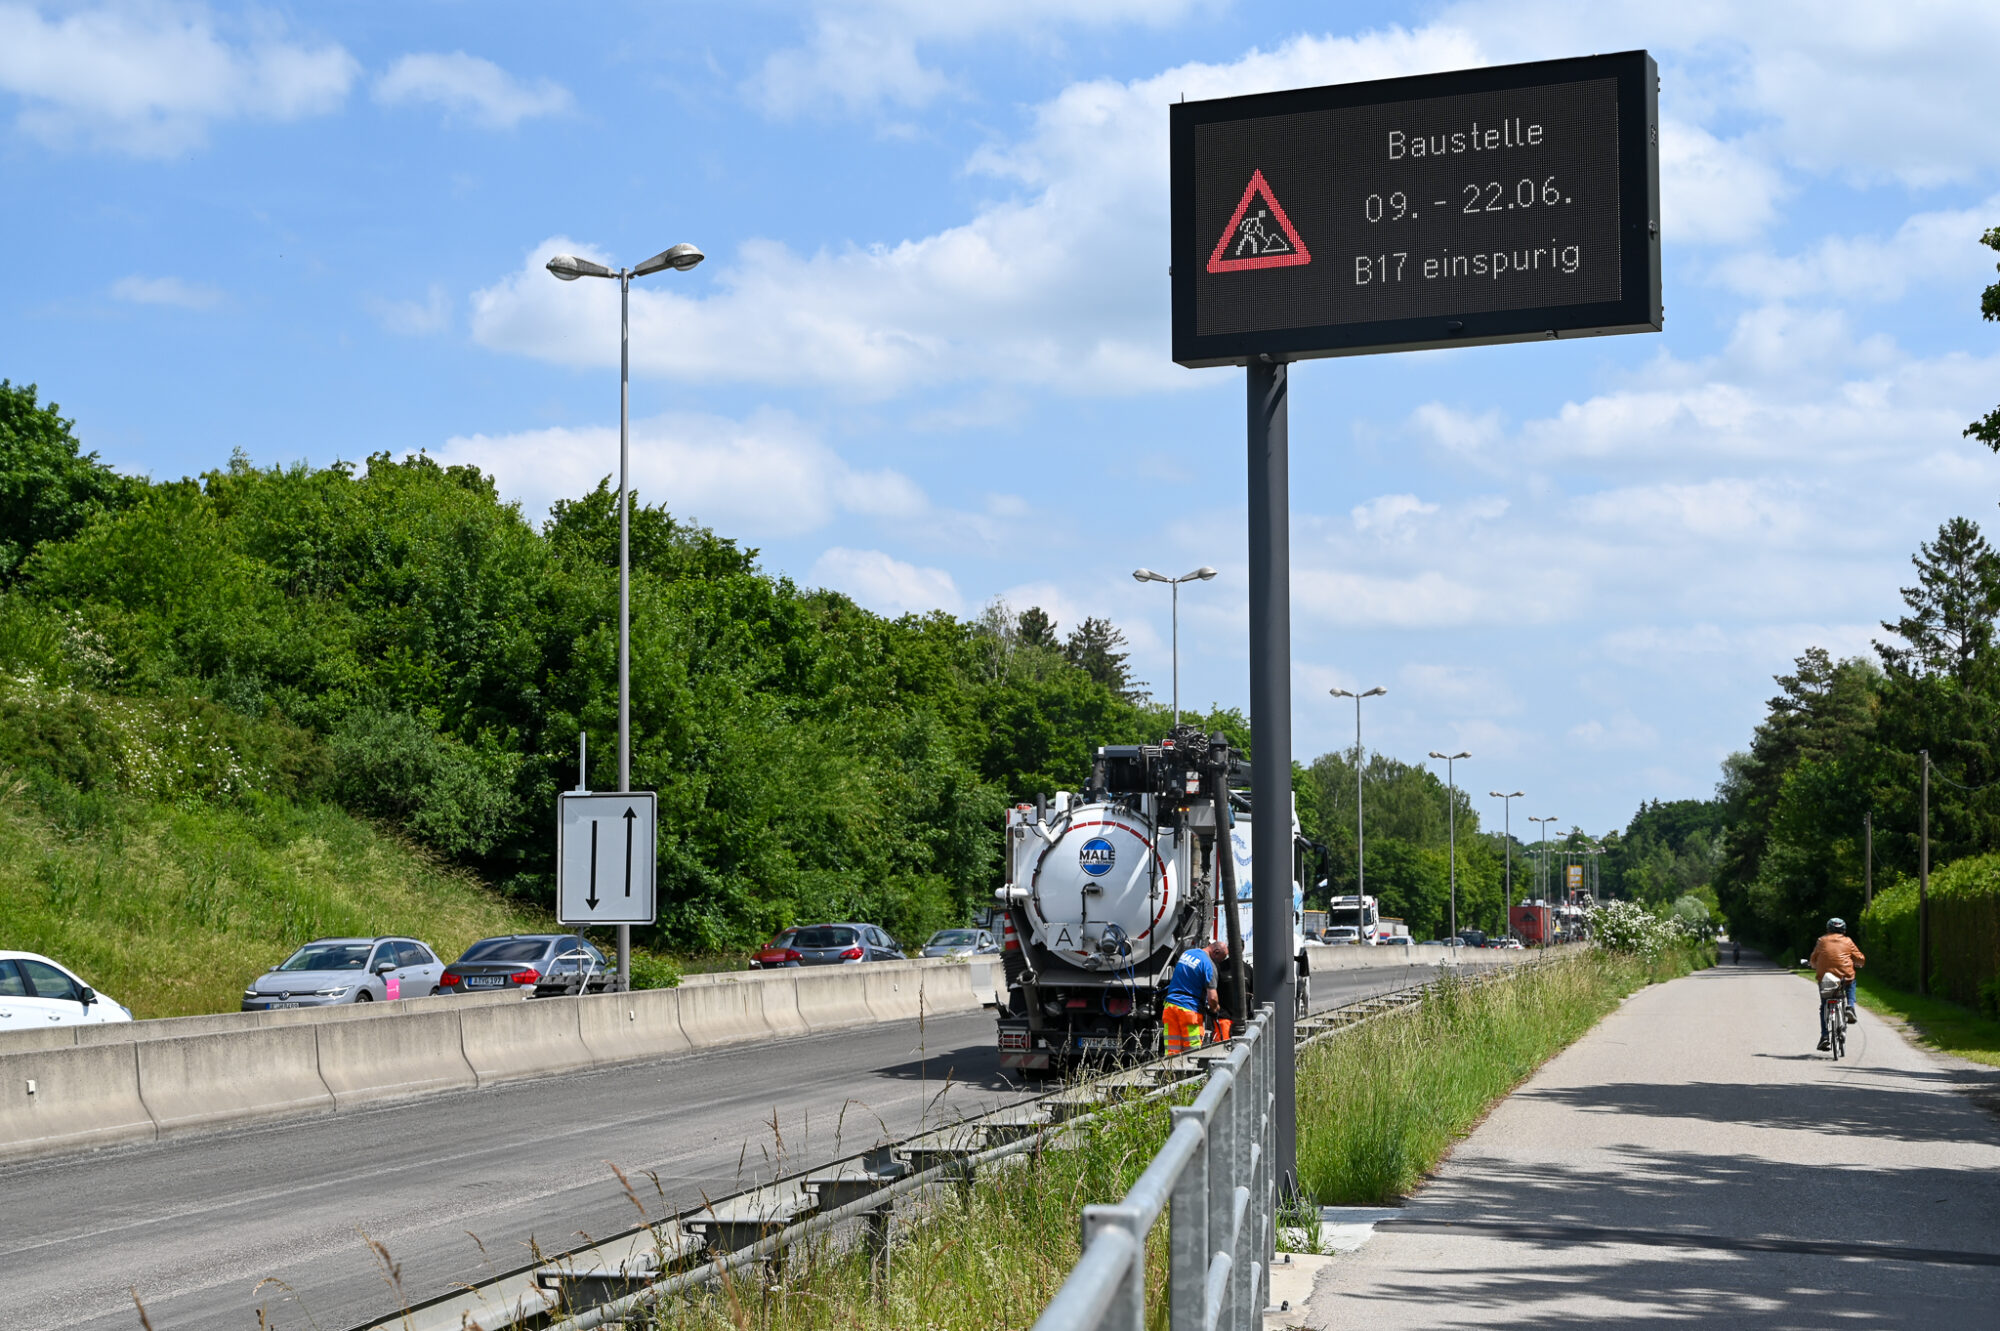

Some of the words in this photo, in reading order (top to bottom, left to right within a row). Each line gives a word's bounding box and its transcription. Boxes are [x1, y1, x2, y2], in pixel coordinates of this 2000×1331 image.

[1389, 117, 1543, 160] Baustelle
[1365, 191, 1419, 223] 09.
[1463, 176, 1572, 214] 22.06.
[1355, 252, 1408, 285] B17
[1424, 238, 1580, 280] einspurig
[1079, 850, 1116, 860] MALE
[1055, 927, 1074, 946] A
